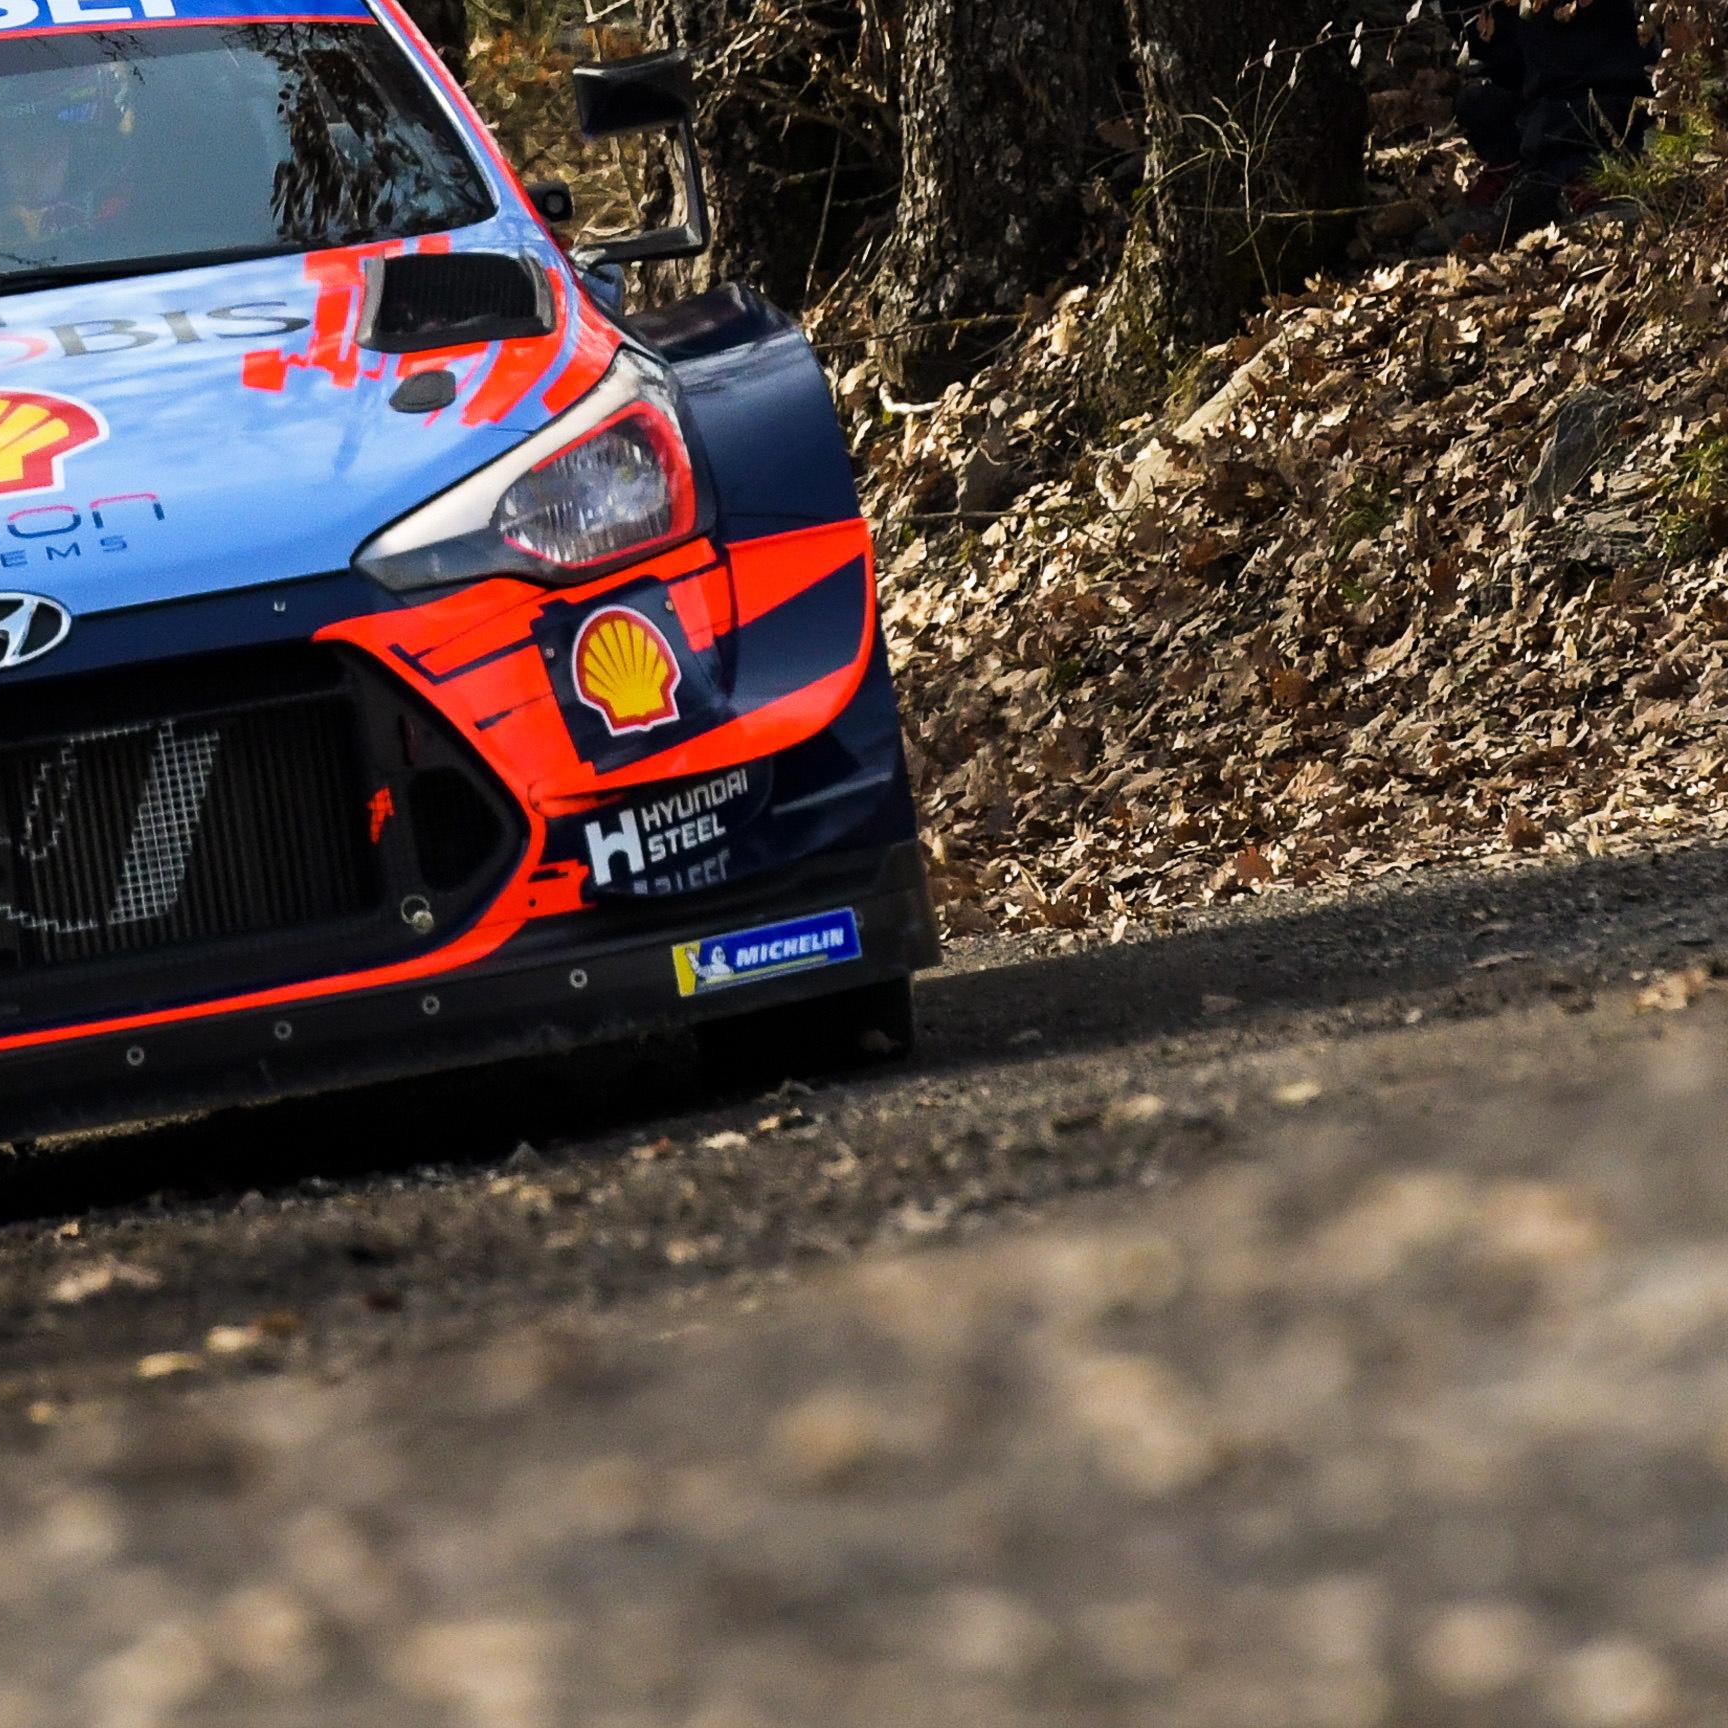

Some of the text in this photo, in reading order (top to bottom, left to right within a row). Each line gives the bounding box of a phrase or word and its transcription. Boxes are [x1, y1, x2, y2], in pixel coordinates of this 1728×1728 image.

[640, 768, 749, 832] HYUNDAI
[647, 812, 727, 863] STEEL
[735, 927, 845, 968] MICHELIN
